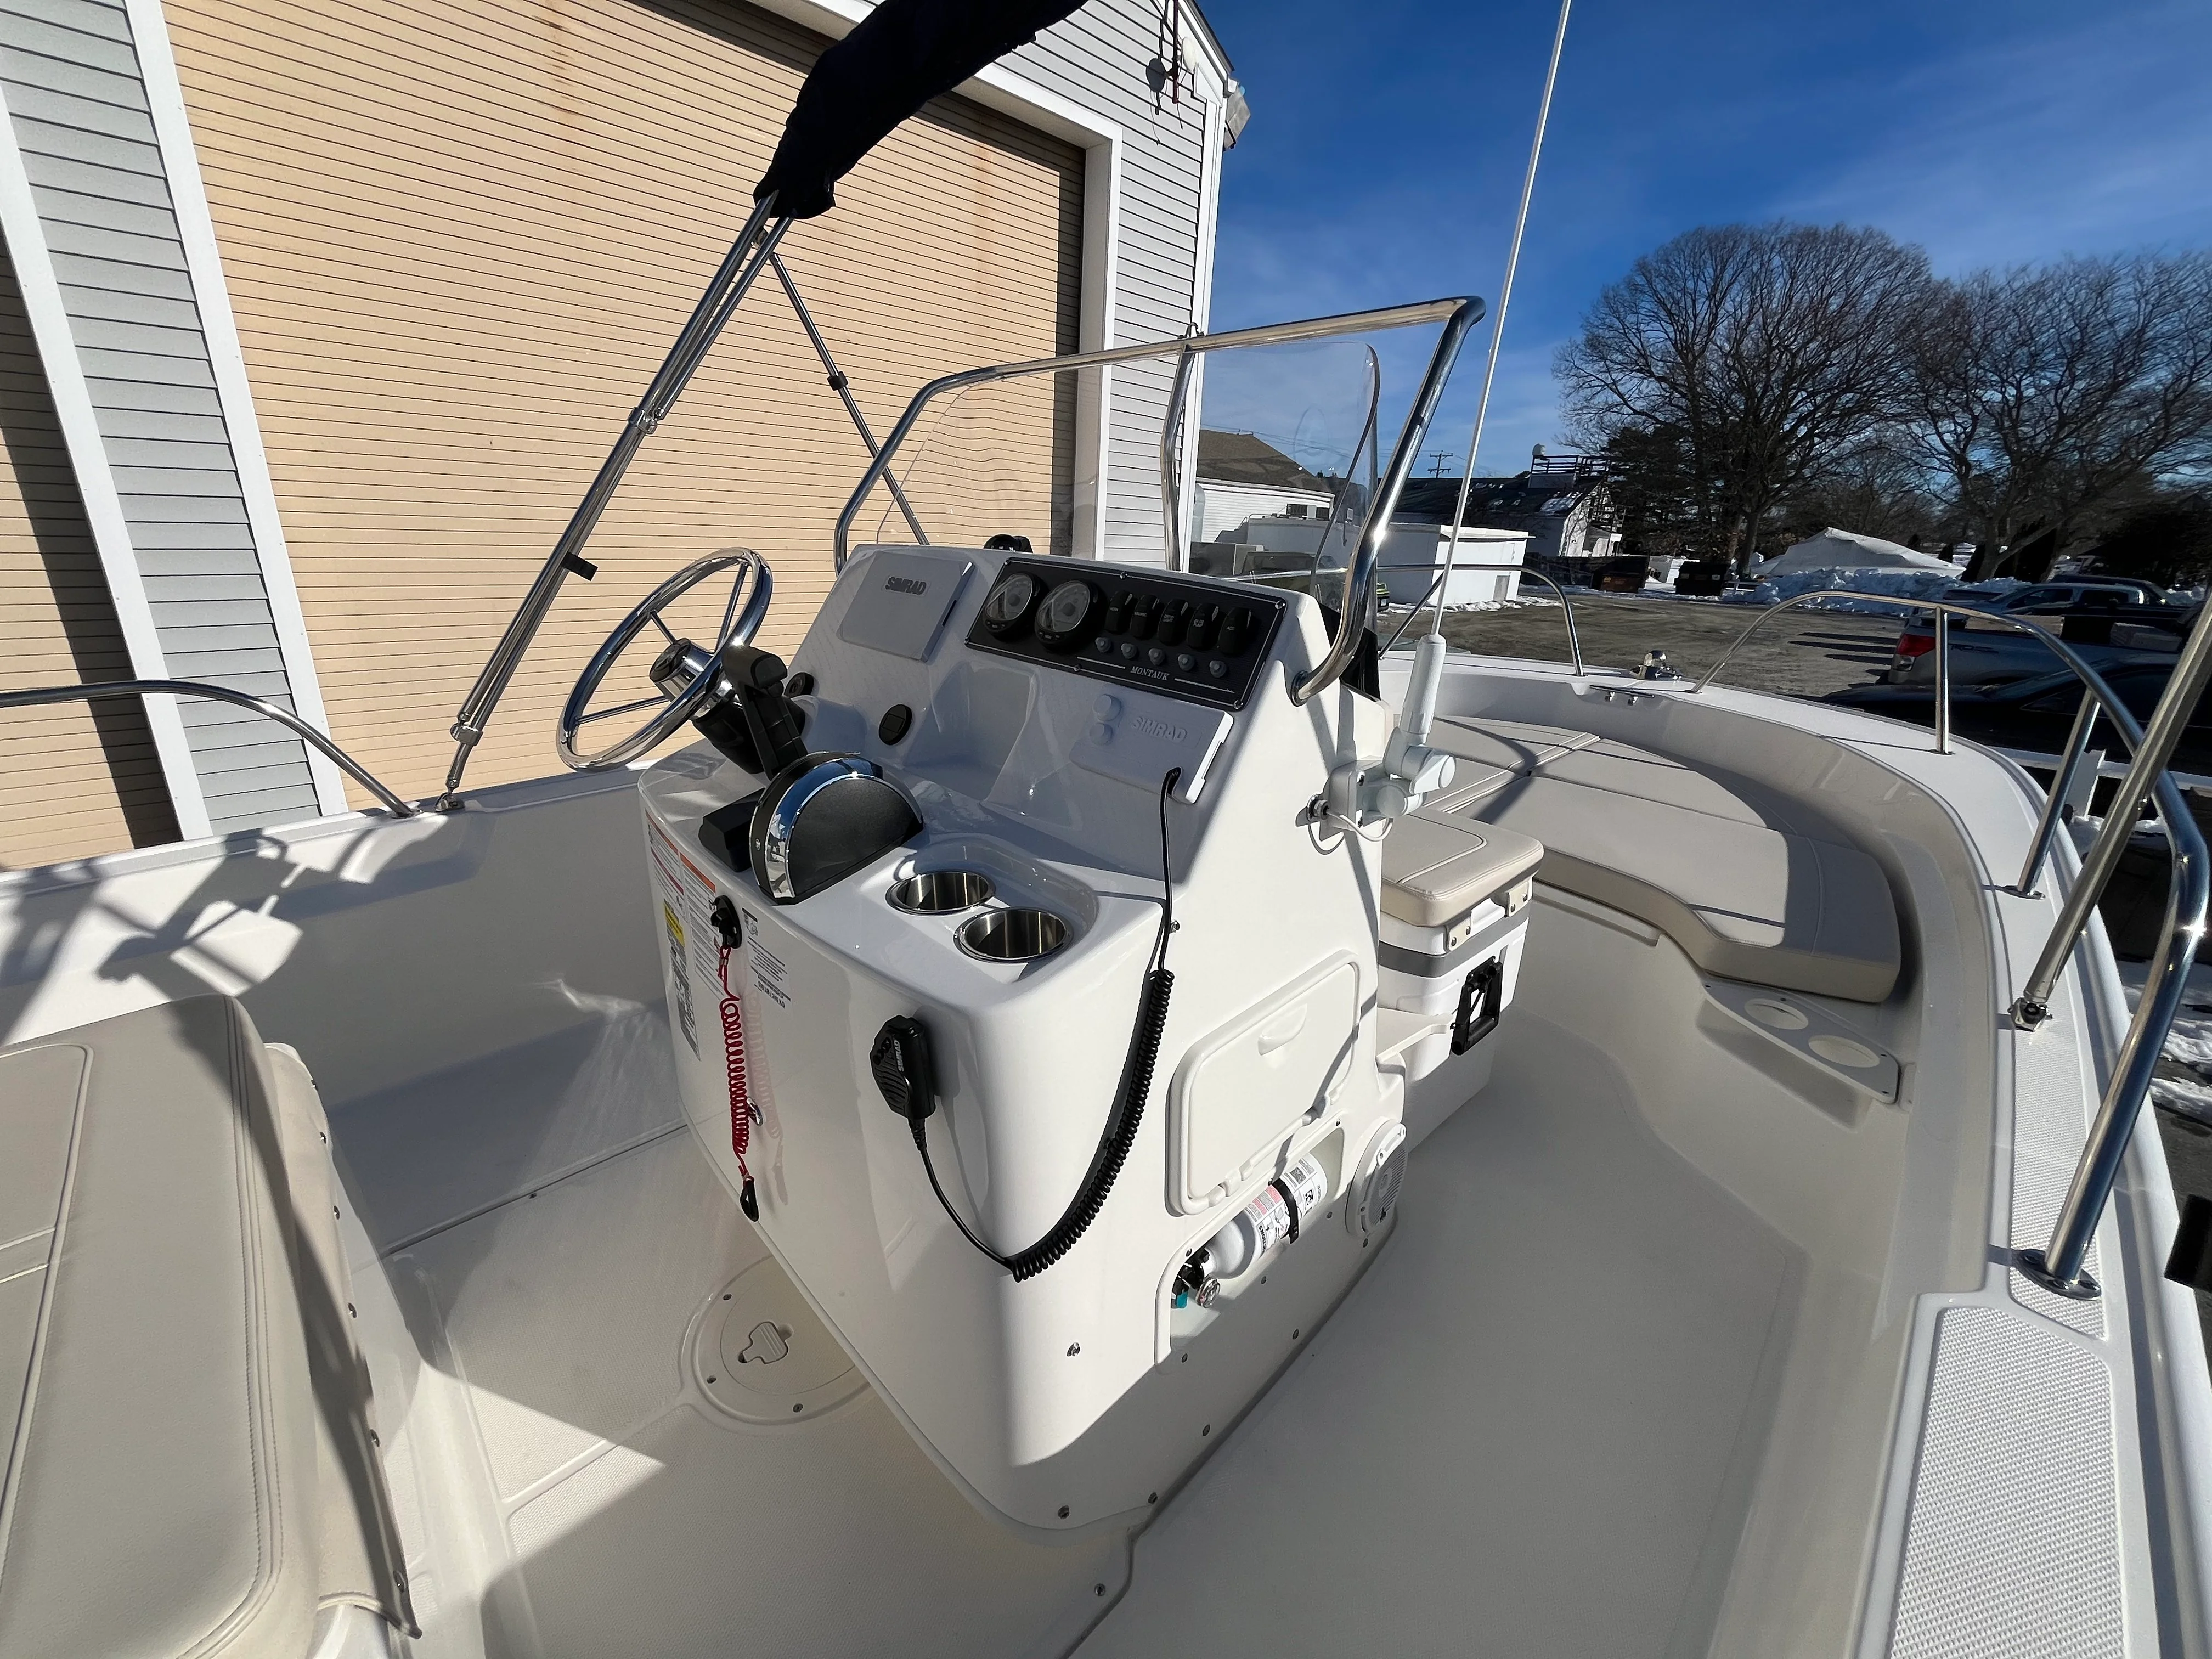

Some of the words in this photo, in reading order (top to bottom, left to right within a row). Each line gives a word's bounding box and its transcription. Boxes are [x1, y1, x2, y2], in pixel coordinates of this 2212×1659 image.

[885, 577, 926, 595] SIMRAD
[1130, 666, 1170, 680] MONTAUK
[1132, 717, 1188, 742] SIMRAD
[894, 1040, 904, 1071] SIMRAD
